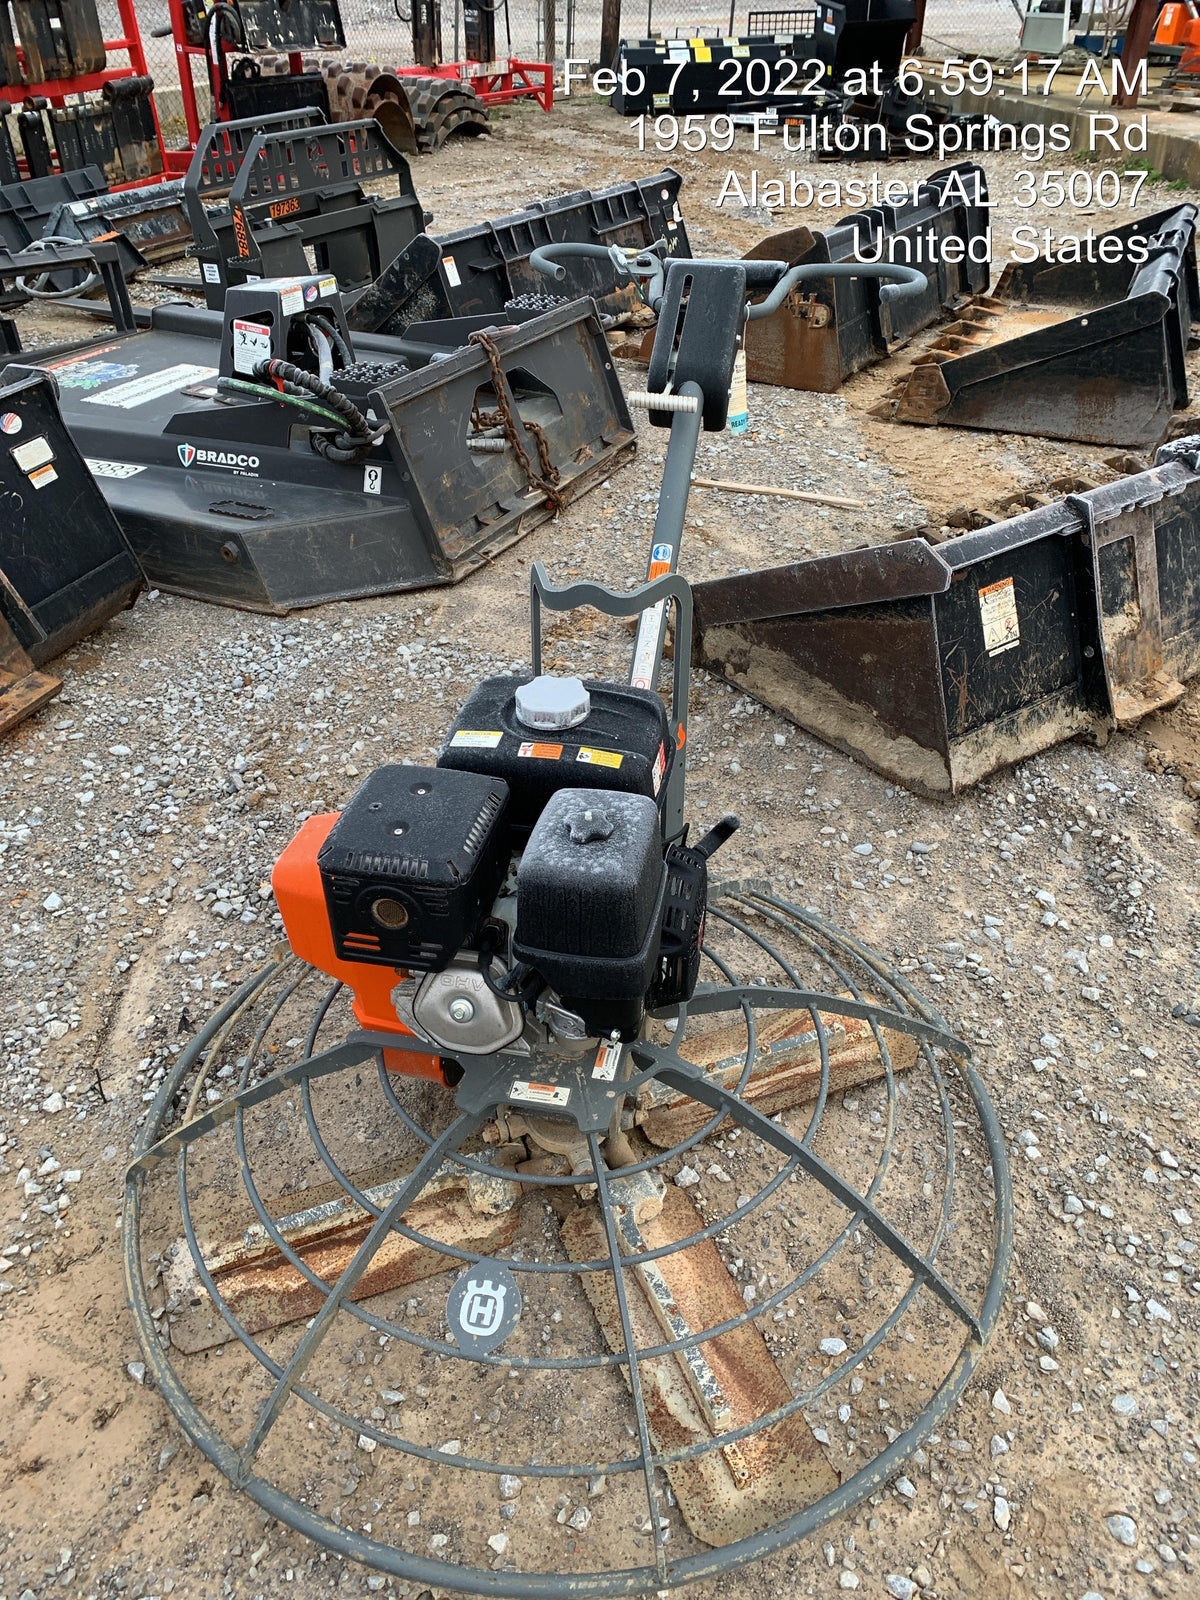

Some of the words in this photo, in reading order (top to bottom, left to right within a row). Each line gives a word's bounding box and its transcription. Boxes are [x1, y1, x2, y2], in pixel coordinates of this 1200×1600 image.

[271, 198, 300, 218] 197363
[196, 449, 260, 468] BRADCO
[440, 974, 485, 992] OHV
